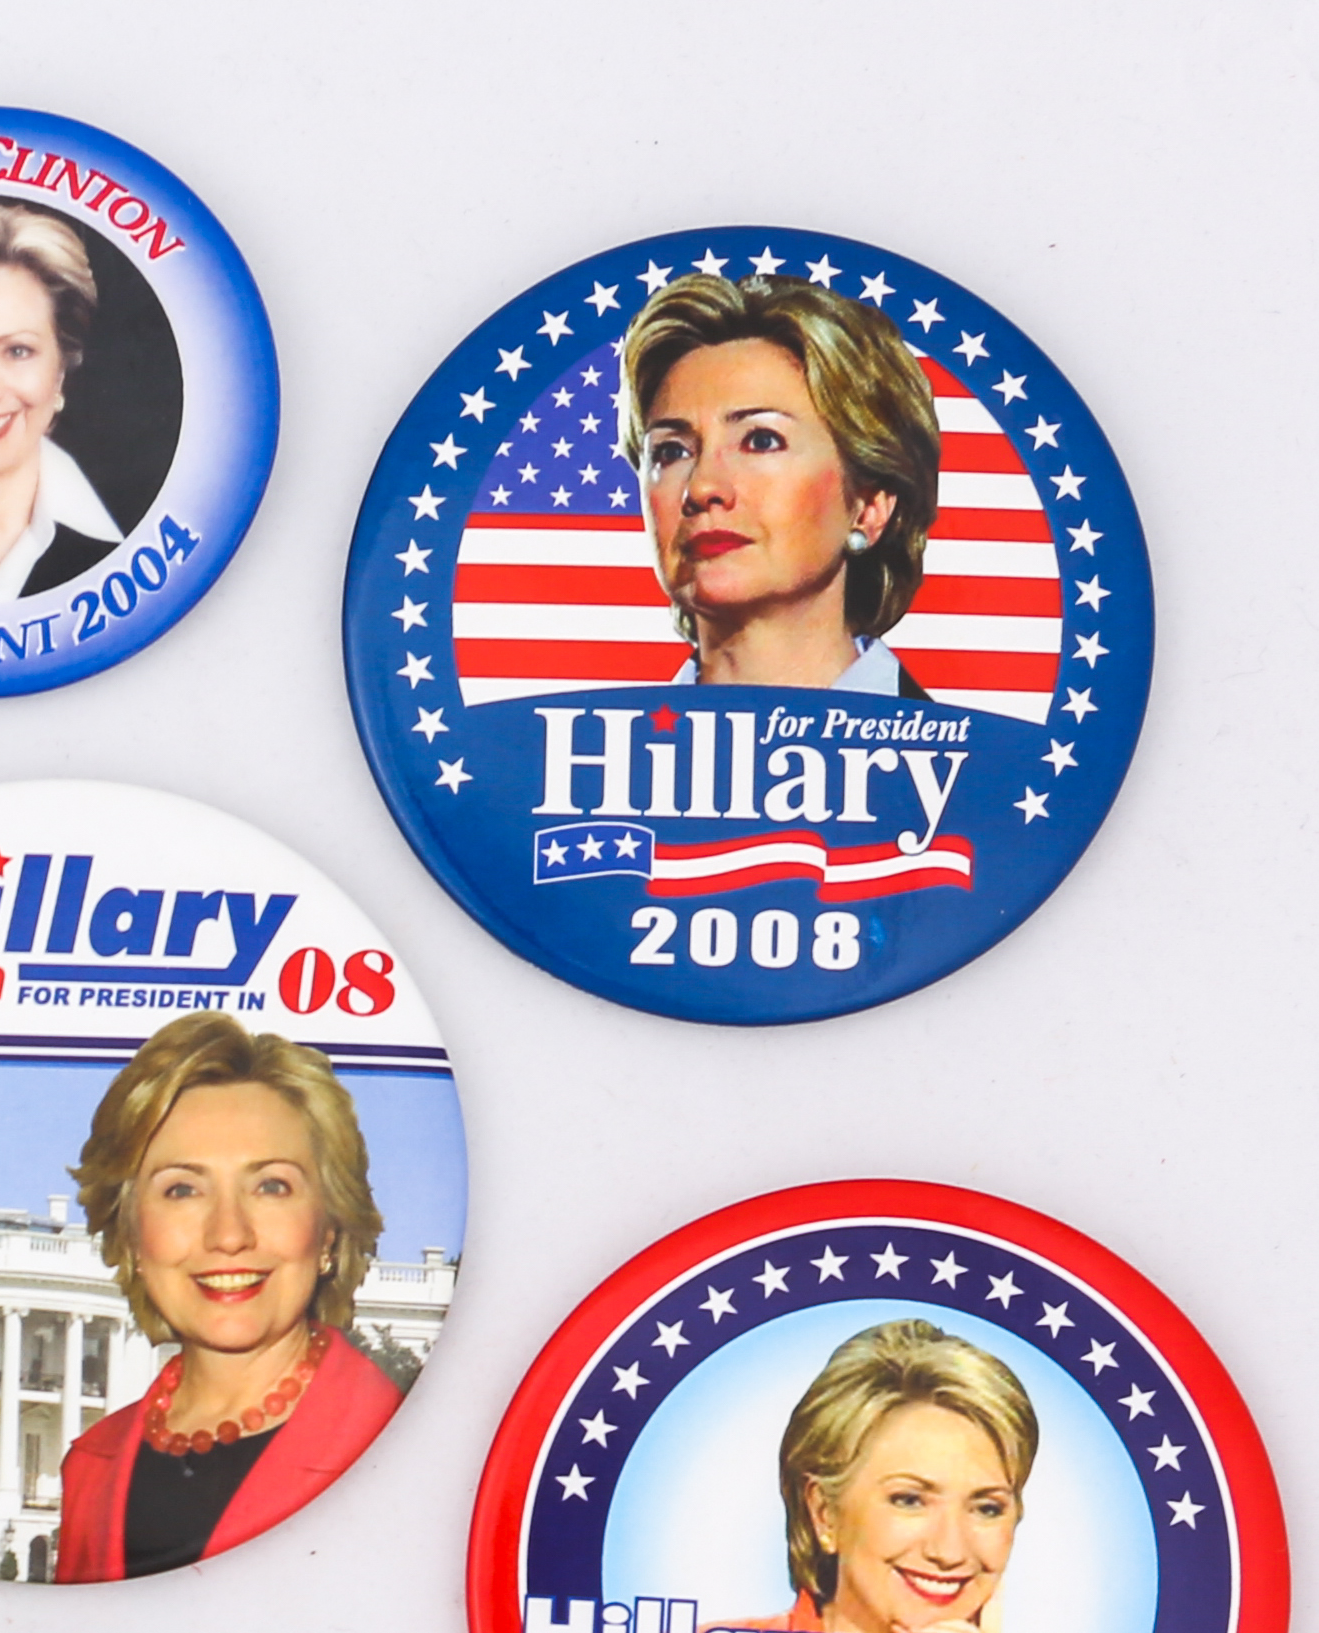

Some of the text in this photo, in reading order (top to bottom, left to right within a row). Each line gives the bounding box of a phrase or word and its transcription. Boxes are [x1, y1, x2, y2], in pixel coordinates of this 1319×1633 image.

[70, 513, 202, 643] 2004
[760, 707, 970, 744] for President
[531, 703, 969, 856] Hillary
[630, 905, 861, 970] 2008
[17, 985, 266, 1012] FOR PRESIDENT IN
[277, 946, 396, 1017] 08
